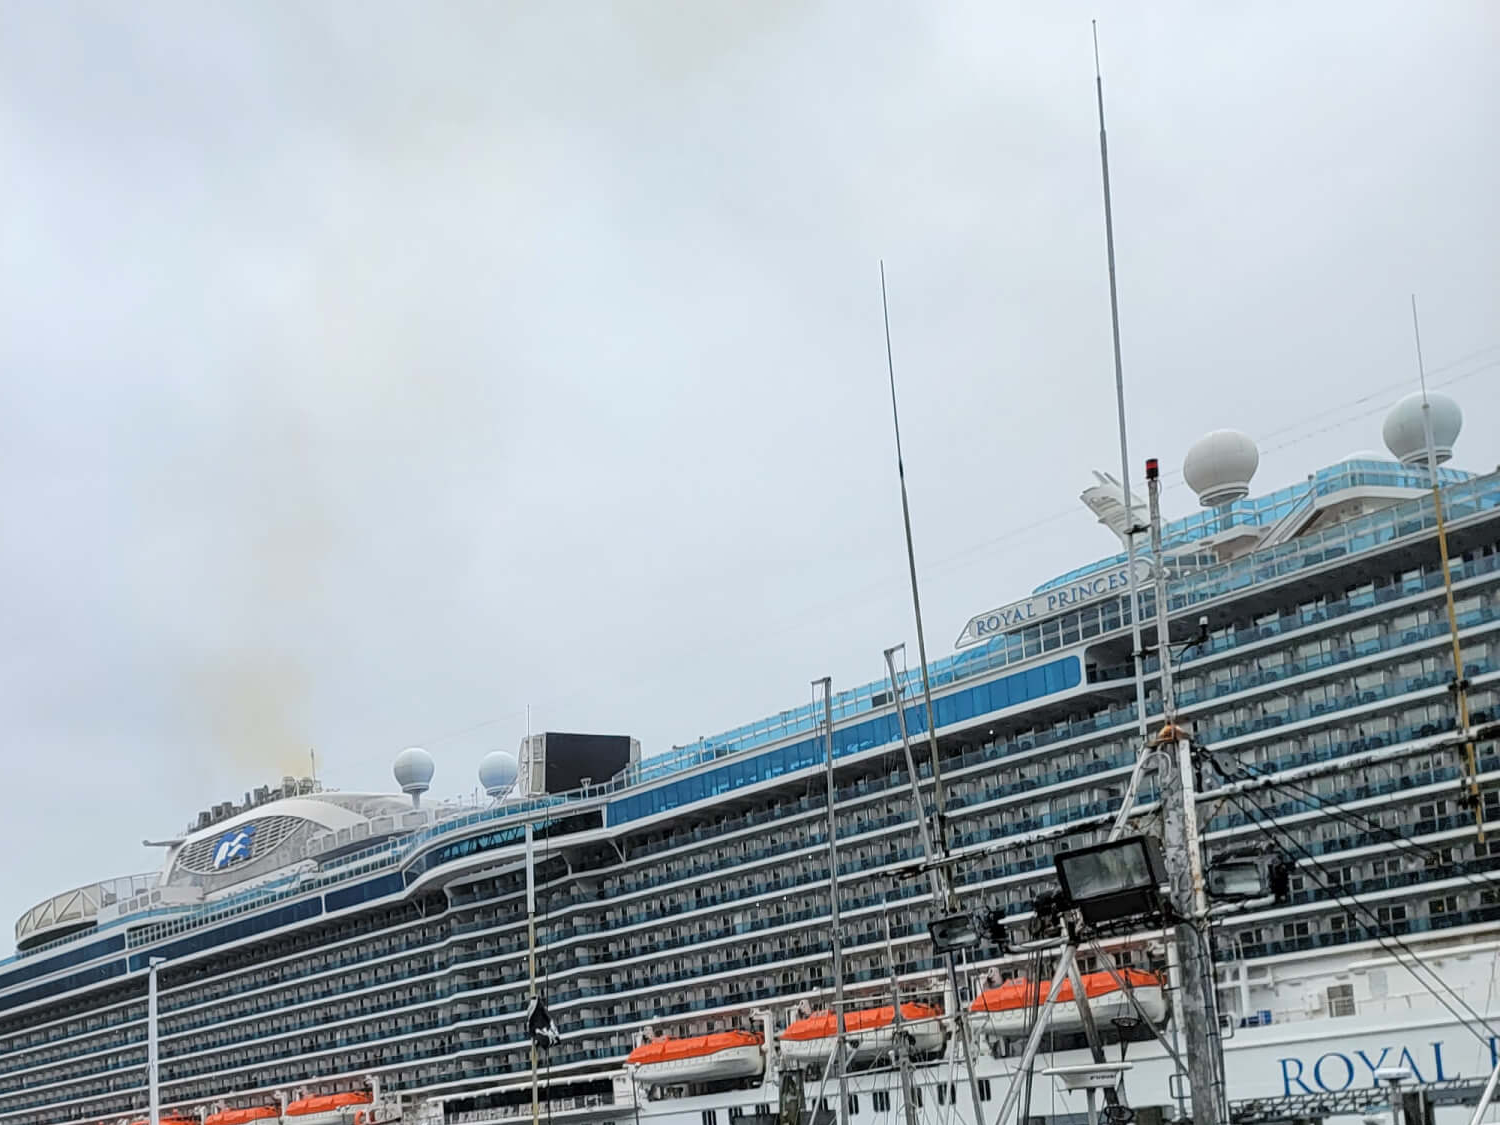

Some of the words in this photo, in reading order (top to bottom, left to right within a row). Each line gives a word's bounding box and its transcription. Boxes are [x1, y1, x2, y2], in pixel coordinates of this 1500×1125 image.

[976, 603, 1036, 636] ROYAL
[1047, 568, 1130, 611] PRINCES
[1277, 1040, 1461, 1098] ROYAL
